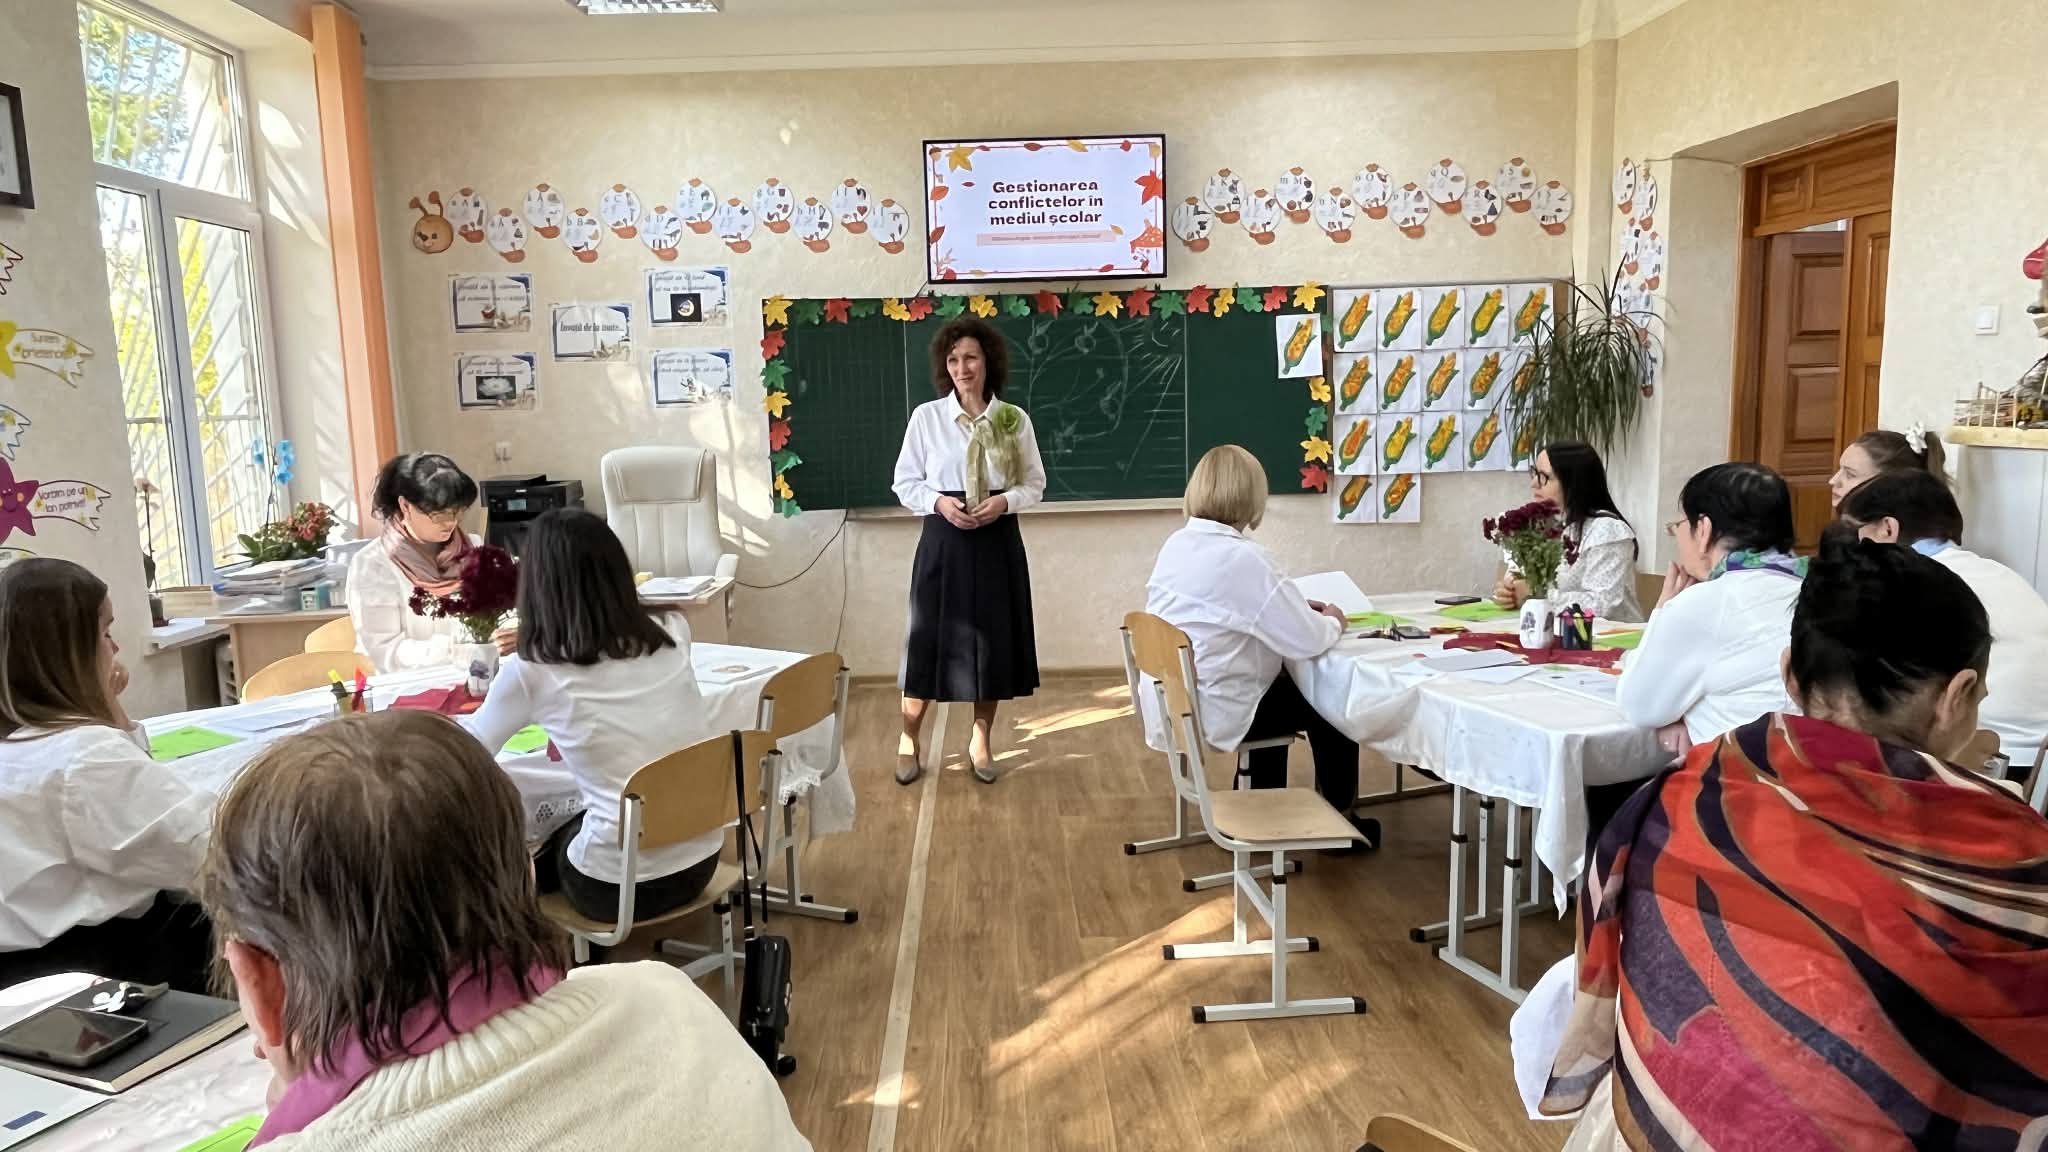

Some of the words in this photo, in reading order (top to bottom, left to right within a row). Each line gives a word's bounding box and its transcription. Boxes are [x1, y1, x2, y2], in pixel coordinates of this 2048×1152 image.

[992, 179, 1098, 193] Gestionarea
[988, 195, 1085, 209] conflictelor
[1087, 195, 1103, 207] în
[990, 211, 1045, 225] mediul
[1049, 210, 1102, 227] școlar
